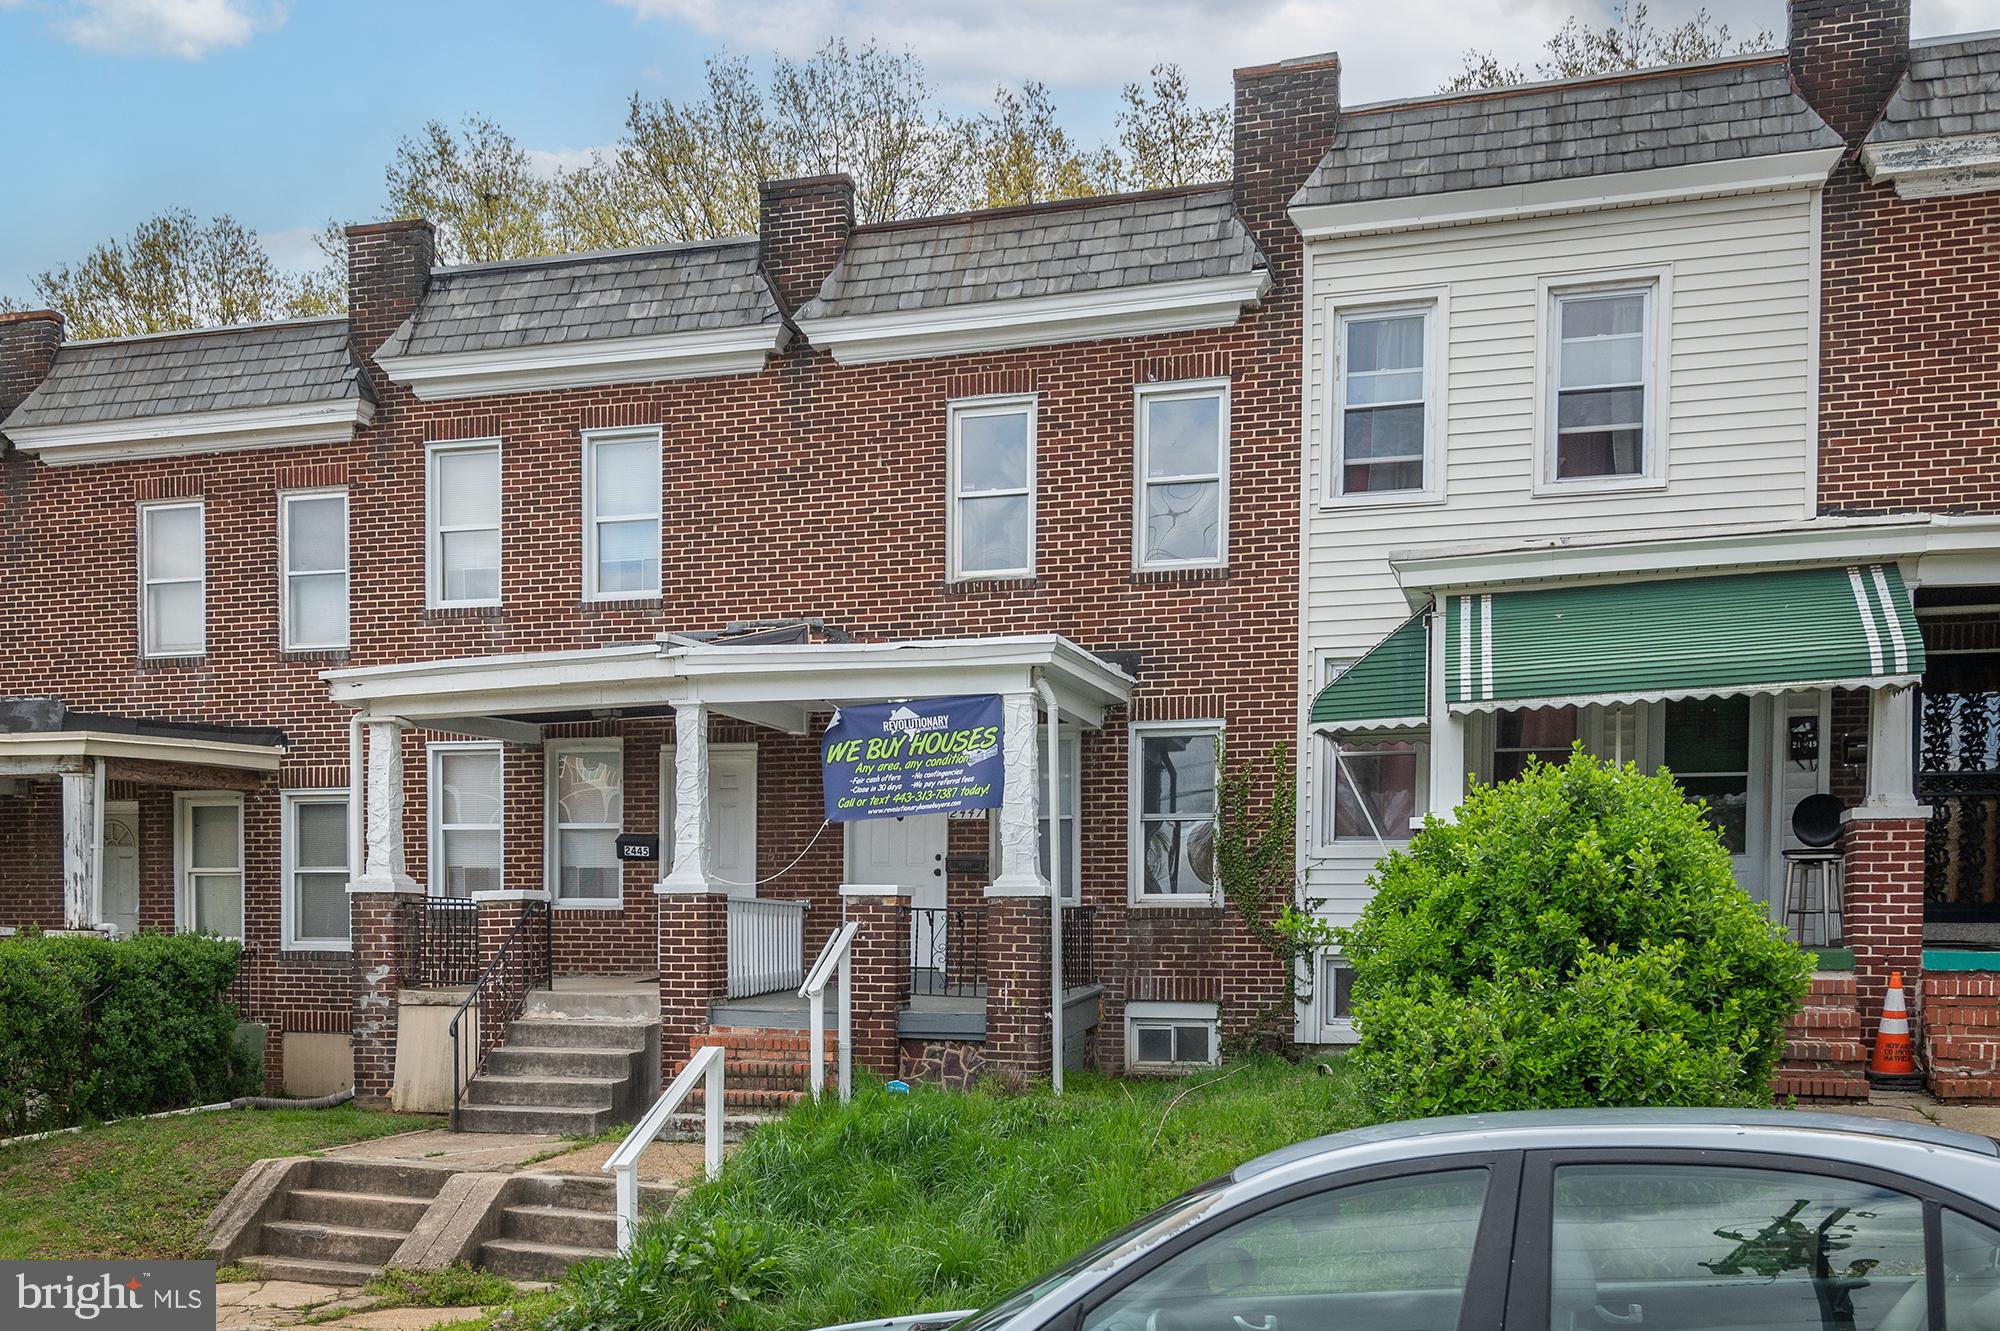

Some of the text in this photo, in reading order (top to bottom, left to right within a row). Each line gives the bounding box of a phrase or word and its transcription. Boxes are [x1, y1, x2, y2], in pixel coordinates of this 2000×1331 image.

[883, 714, 949, 732] REVOLUTIONARY
[826, 726, 999, 763] WE BUY HOUSES
[855, 762, 875, 775] Any
[877, 761, 902, 772] area,
[905, 760, 923, 771] any
[923, 768, 964, 779] contingencies
[865, 774, 881, 784] cash
[881, 773, 902, 783] offers
[923, 780, 937, 789] pay
[936, 777, 961, 786] referral
[961, 775, 975, 784] fees
[870, 785, 877, 793] in
[877, 783, 887, 792] 30
[887, 782, 903, 792] days
[837, 783, 991, 809] Call or text 443-313-7387 today!
[867, 800, 962, 815] www.revolutionaryhomebuyers.com
[625, 846, 649, 856] 2445
